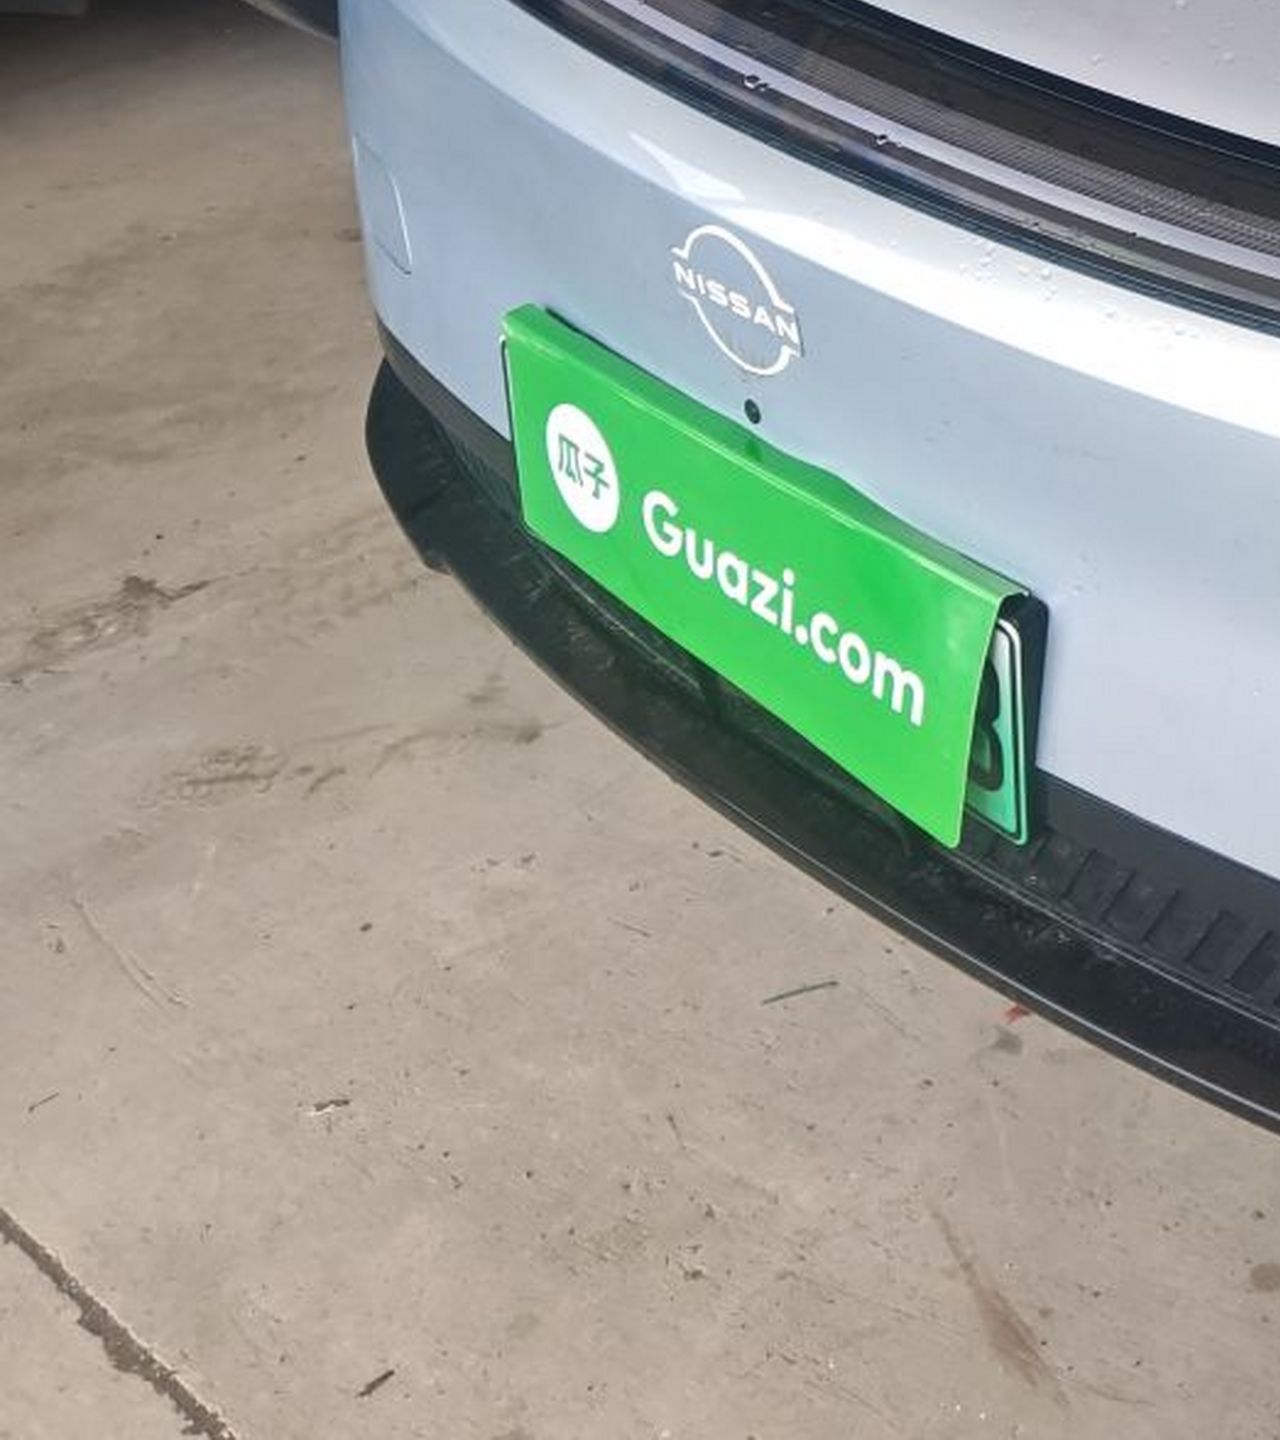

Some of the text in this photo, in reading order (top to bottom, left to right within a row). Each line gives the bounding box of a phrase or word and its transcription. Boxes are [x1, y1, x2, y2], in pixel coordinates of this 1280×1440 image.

[673, 261, 799, 344] NISSAN
[558, 433, 611, 500] 瓜子
[642, 490, 925, 728] Guazi.com
